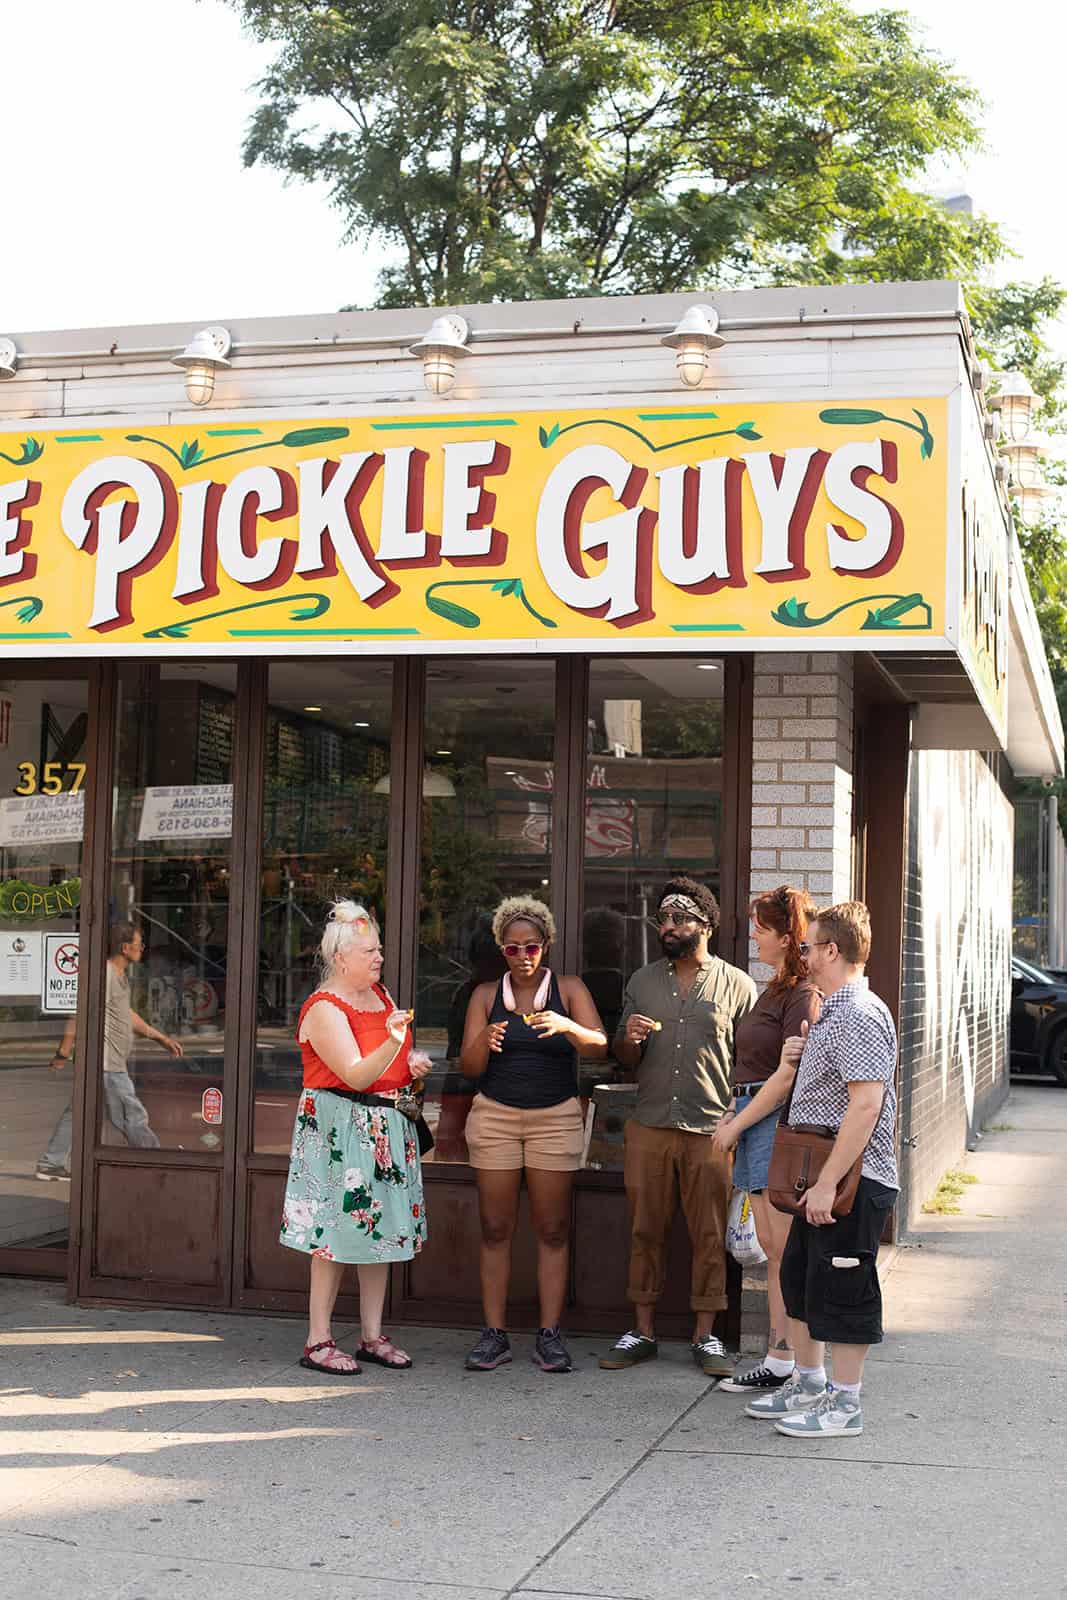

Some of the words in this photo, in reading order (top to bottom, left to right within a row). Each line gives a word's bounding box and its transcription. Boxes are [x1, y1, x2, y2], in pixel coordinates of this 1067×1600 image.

[61, 439, 511, 633] PICKLE
[536, 437, 904, 628] GUYS
[15, 761, 87, 795] 357
[12, 888, 73, 915] OPEN
[50, 979, 63, 991] NO
[65, 979, 77, 991] PE
